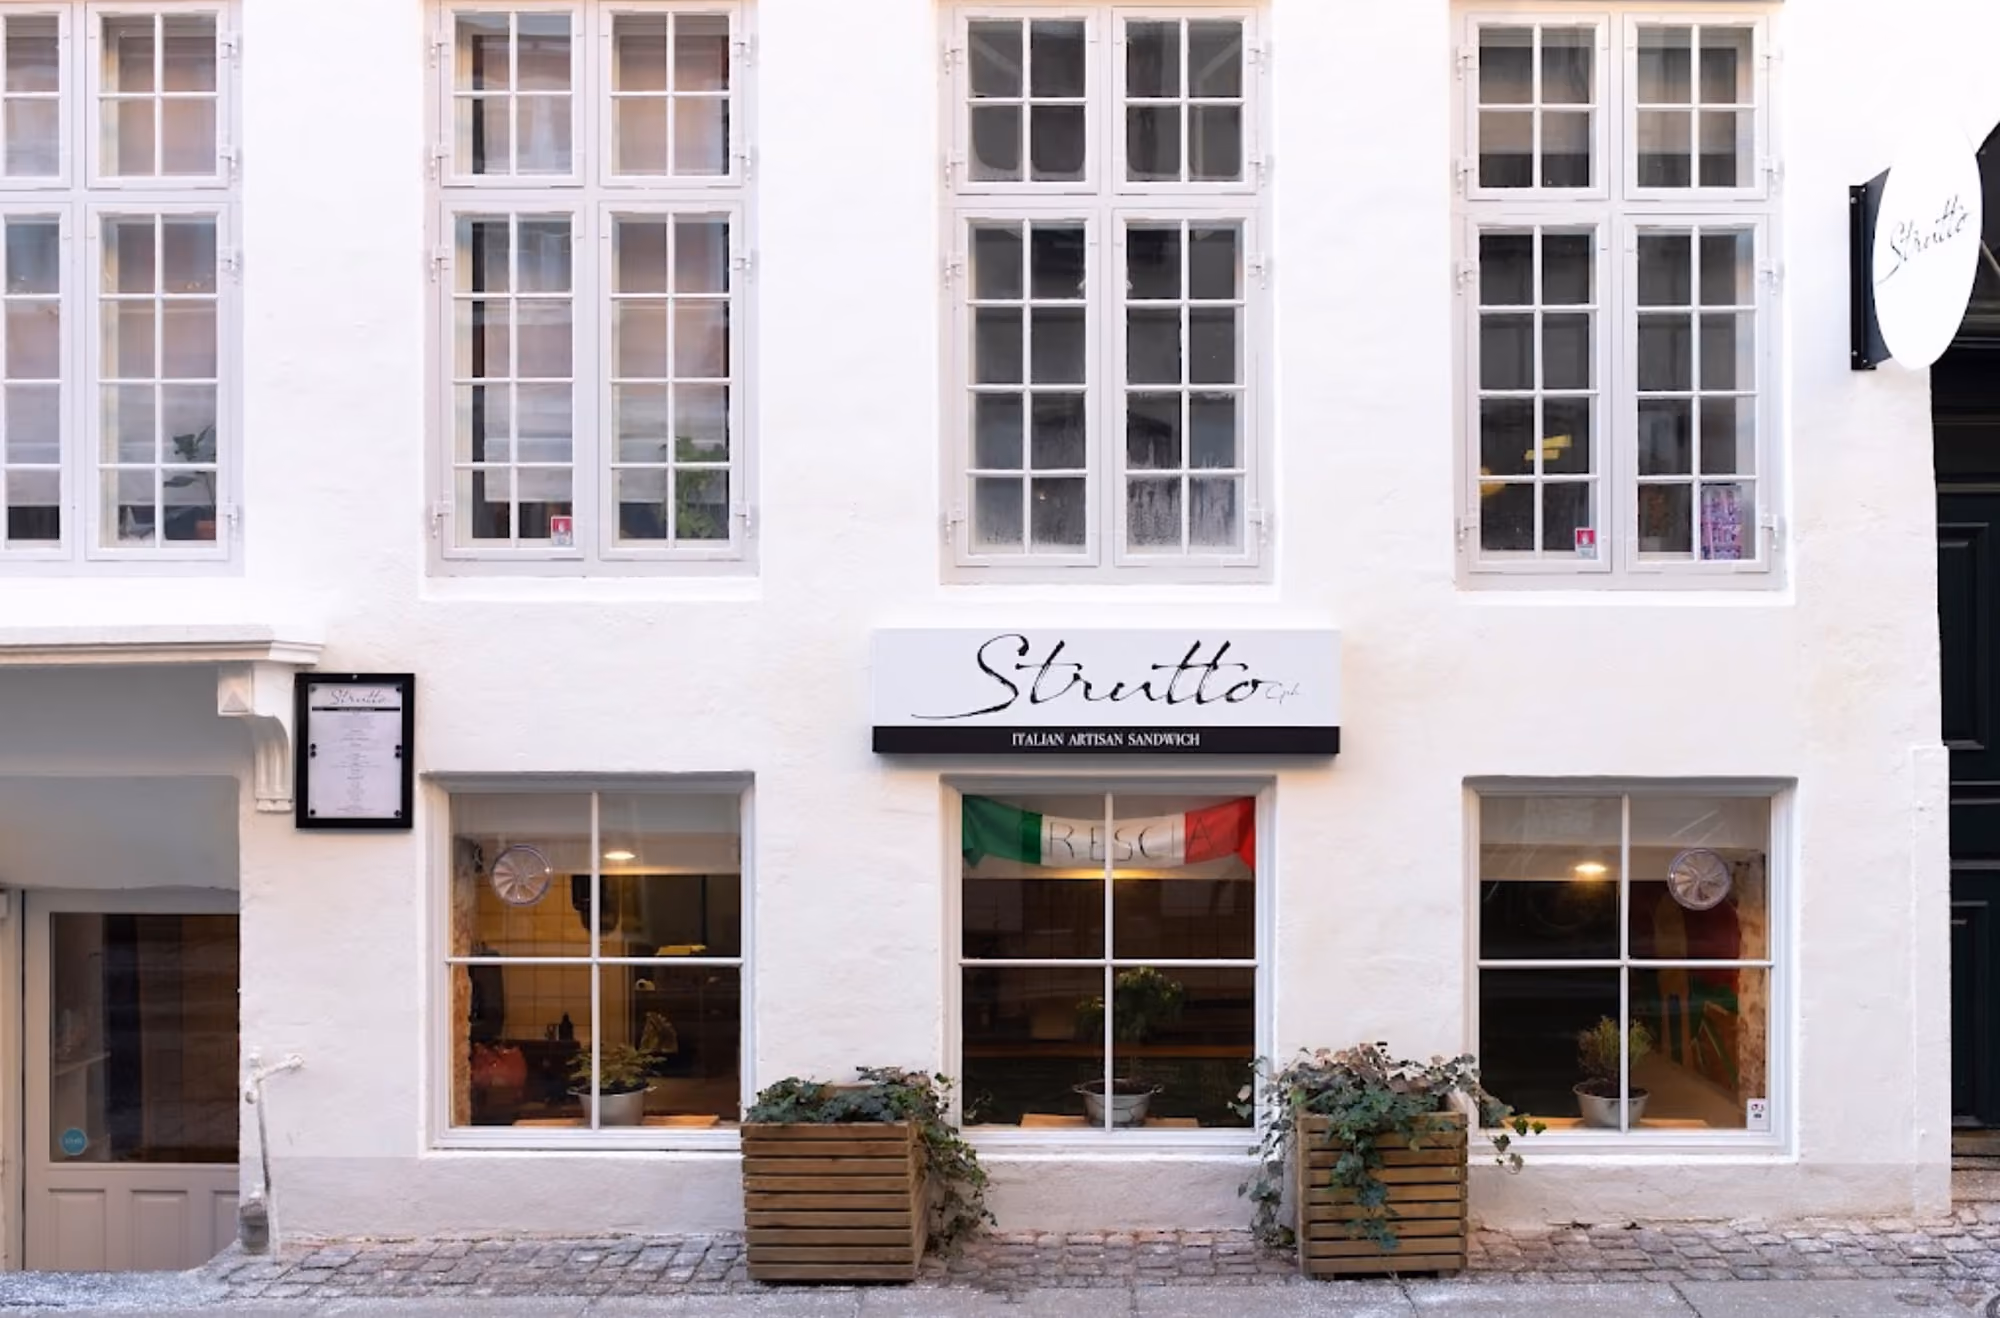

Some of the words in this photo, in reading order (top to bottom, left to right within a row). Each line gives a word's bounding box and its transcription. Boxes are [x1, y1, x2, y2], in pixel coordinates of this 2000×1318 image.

[1875, 193, 1973, 286] Strutto
[911, 634, 1282, 719] Strutto
[1012, 732, 1064, 746] ITALIAN
[1068, 732, 1123, 746] ARTISAN
[1128, 732, 1200, 746] SANDWICH
[1018, 817, 1213, 862] RESCIA
